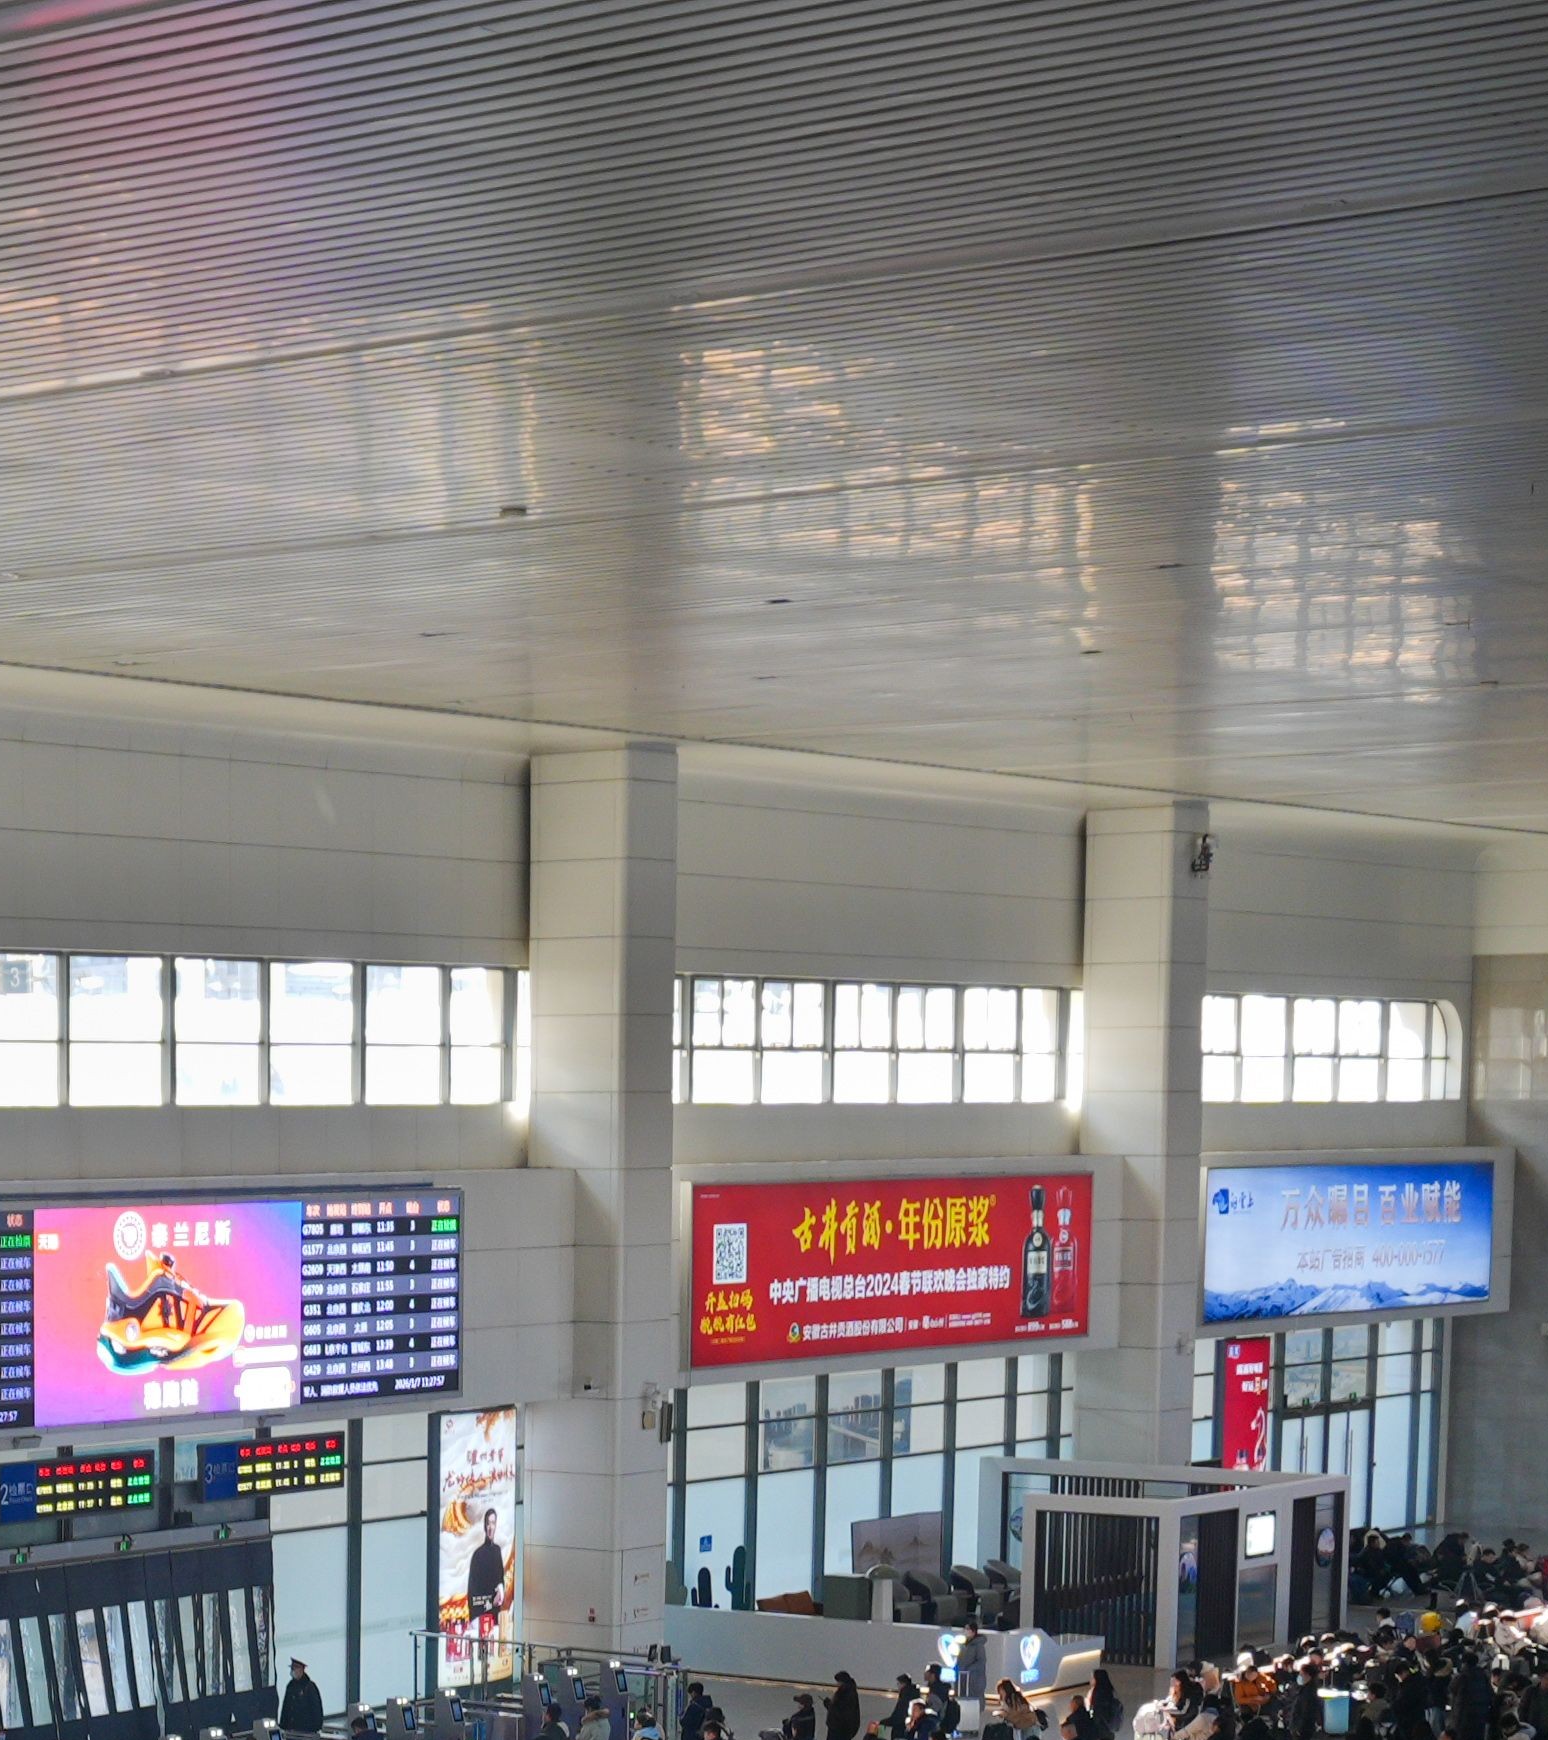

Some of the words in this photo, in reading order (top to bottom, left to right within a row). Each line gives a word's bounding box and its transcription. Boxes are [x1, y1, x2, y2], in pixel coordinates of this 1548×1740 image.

[1281, 1184, 1369, 1231] 万众瞩目
[1379, 1181, 1462, 1225] 百业赋能
